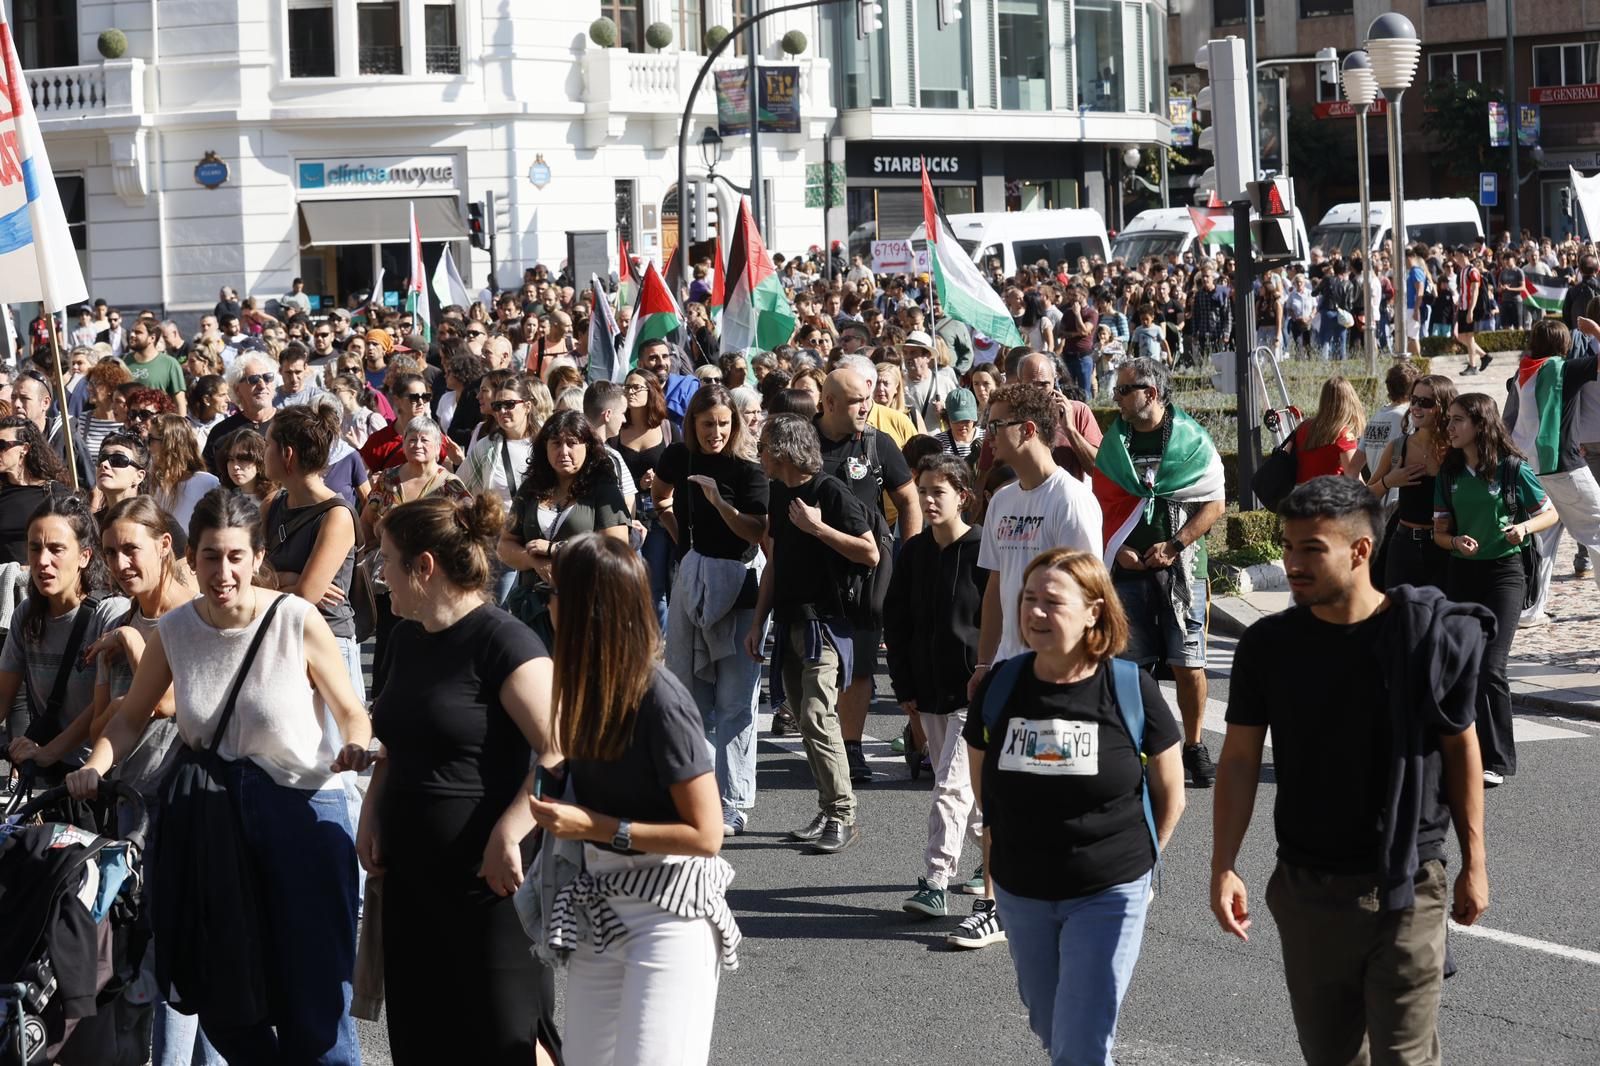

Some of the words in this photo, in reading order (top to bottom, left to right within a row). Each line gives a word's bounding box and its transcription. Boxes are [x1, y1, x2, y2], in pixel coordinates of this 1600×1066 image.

[1553, 87, 1598, 100] GENERALI
[873, 156, 959, 172] STARBUCKS
[389, 165, 454, 188] moyua
